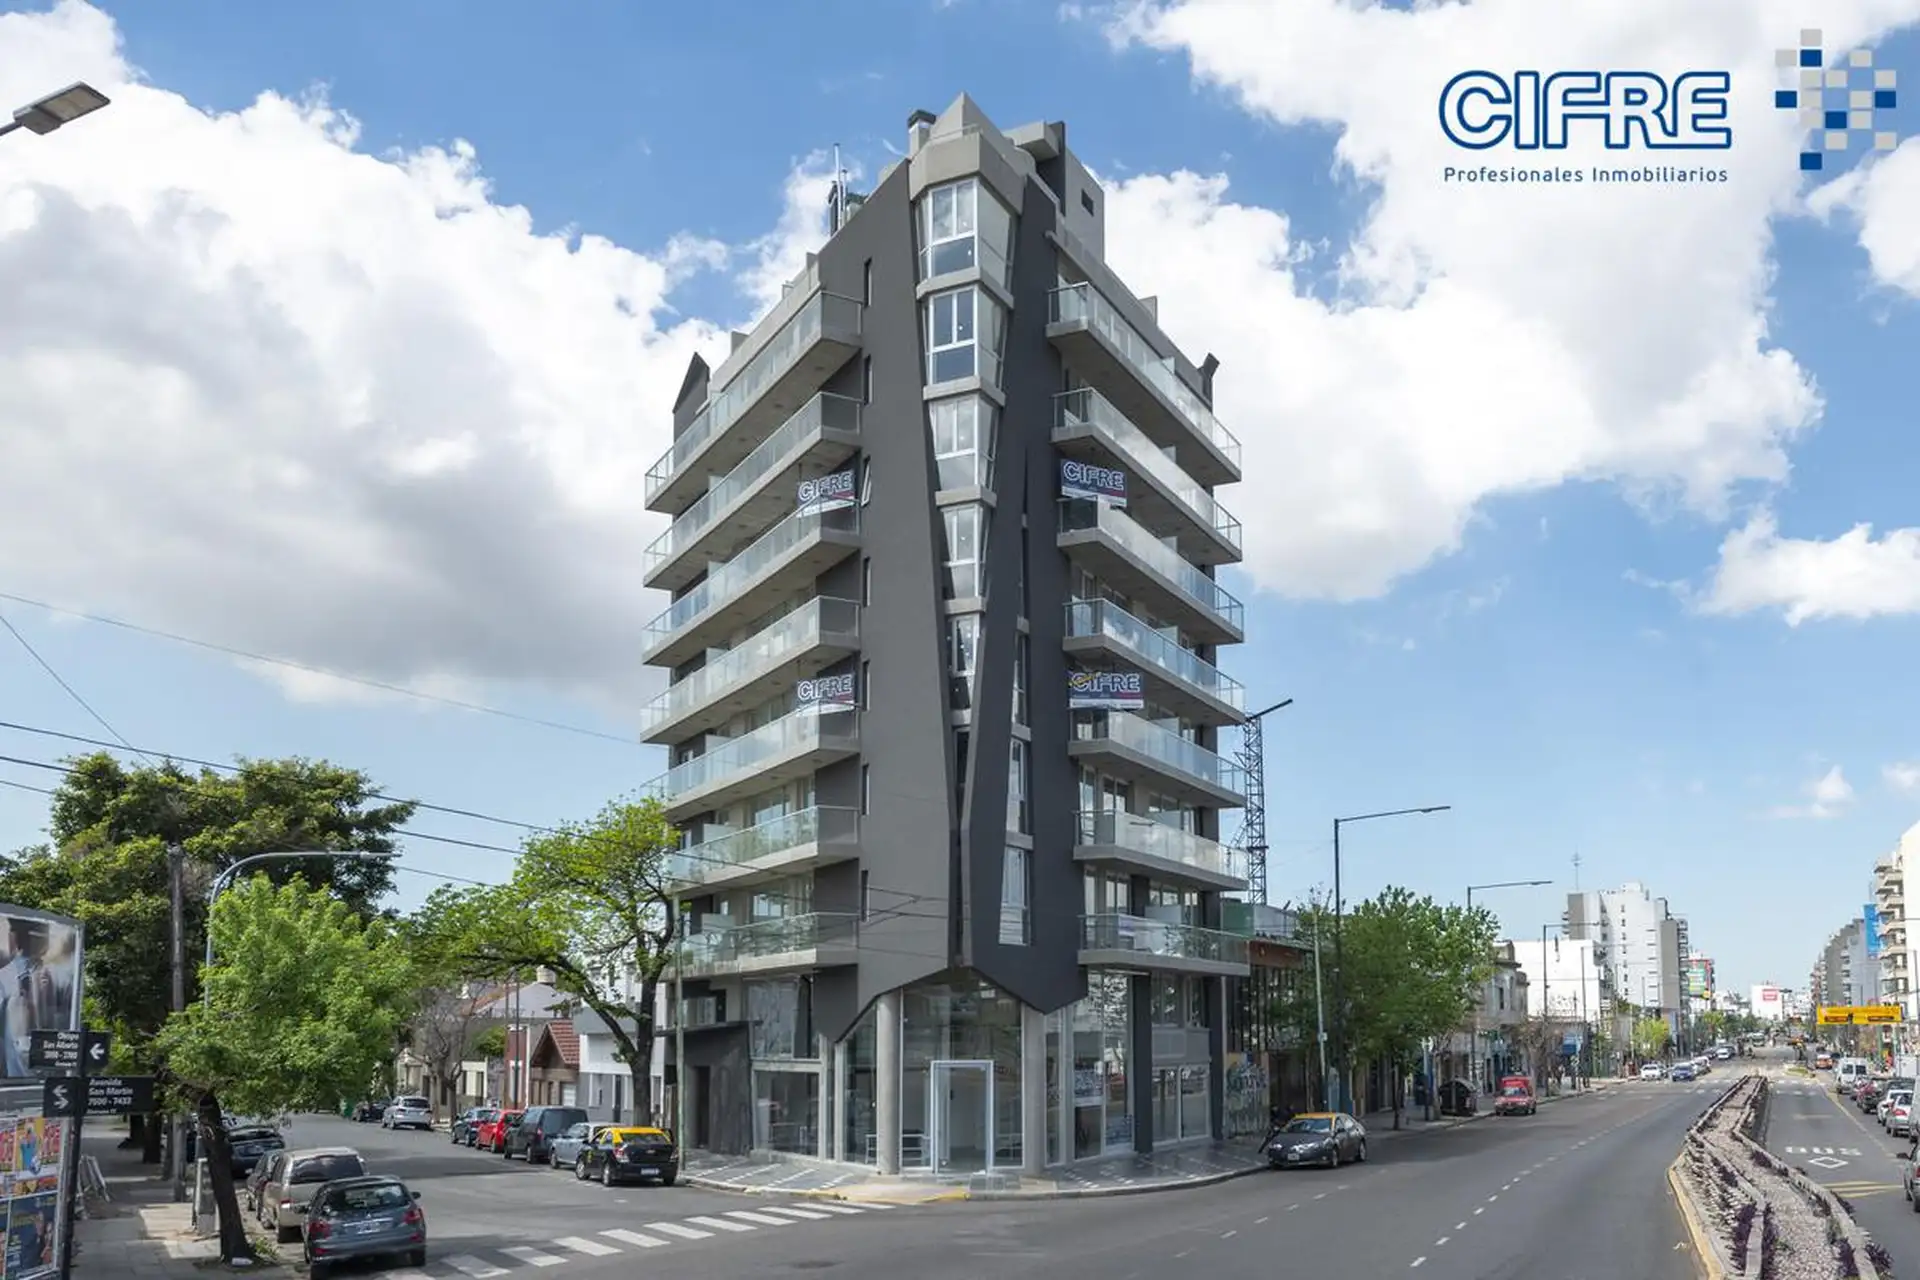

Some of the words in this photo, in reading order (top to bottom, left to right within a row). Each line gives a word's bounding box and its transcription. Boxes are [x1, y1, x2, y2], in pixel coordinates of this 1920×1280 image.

[798, 471, 853, 501] CIFRE
[1063, 461, 1125, 491] CIFRE
[797, 674, 853, 700] CIFRE
[1071, 672, 1141, 693] CIFRE
[89, 1087, 105, 1096] San
